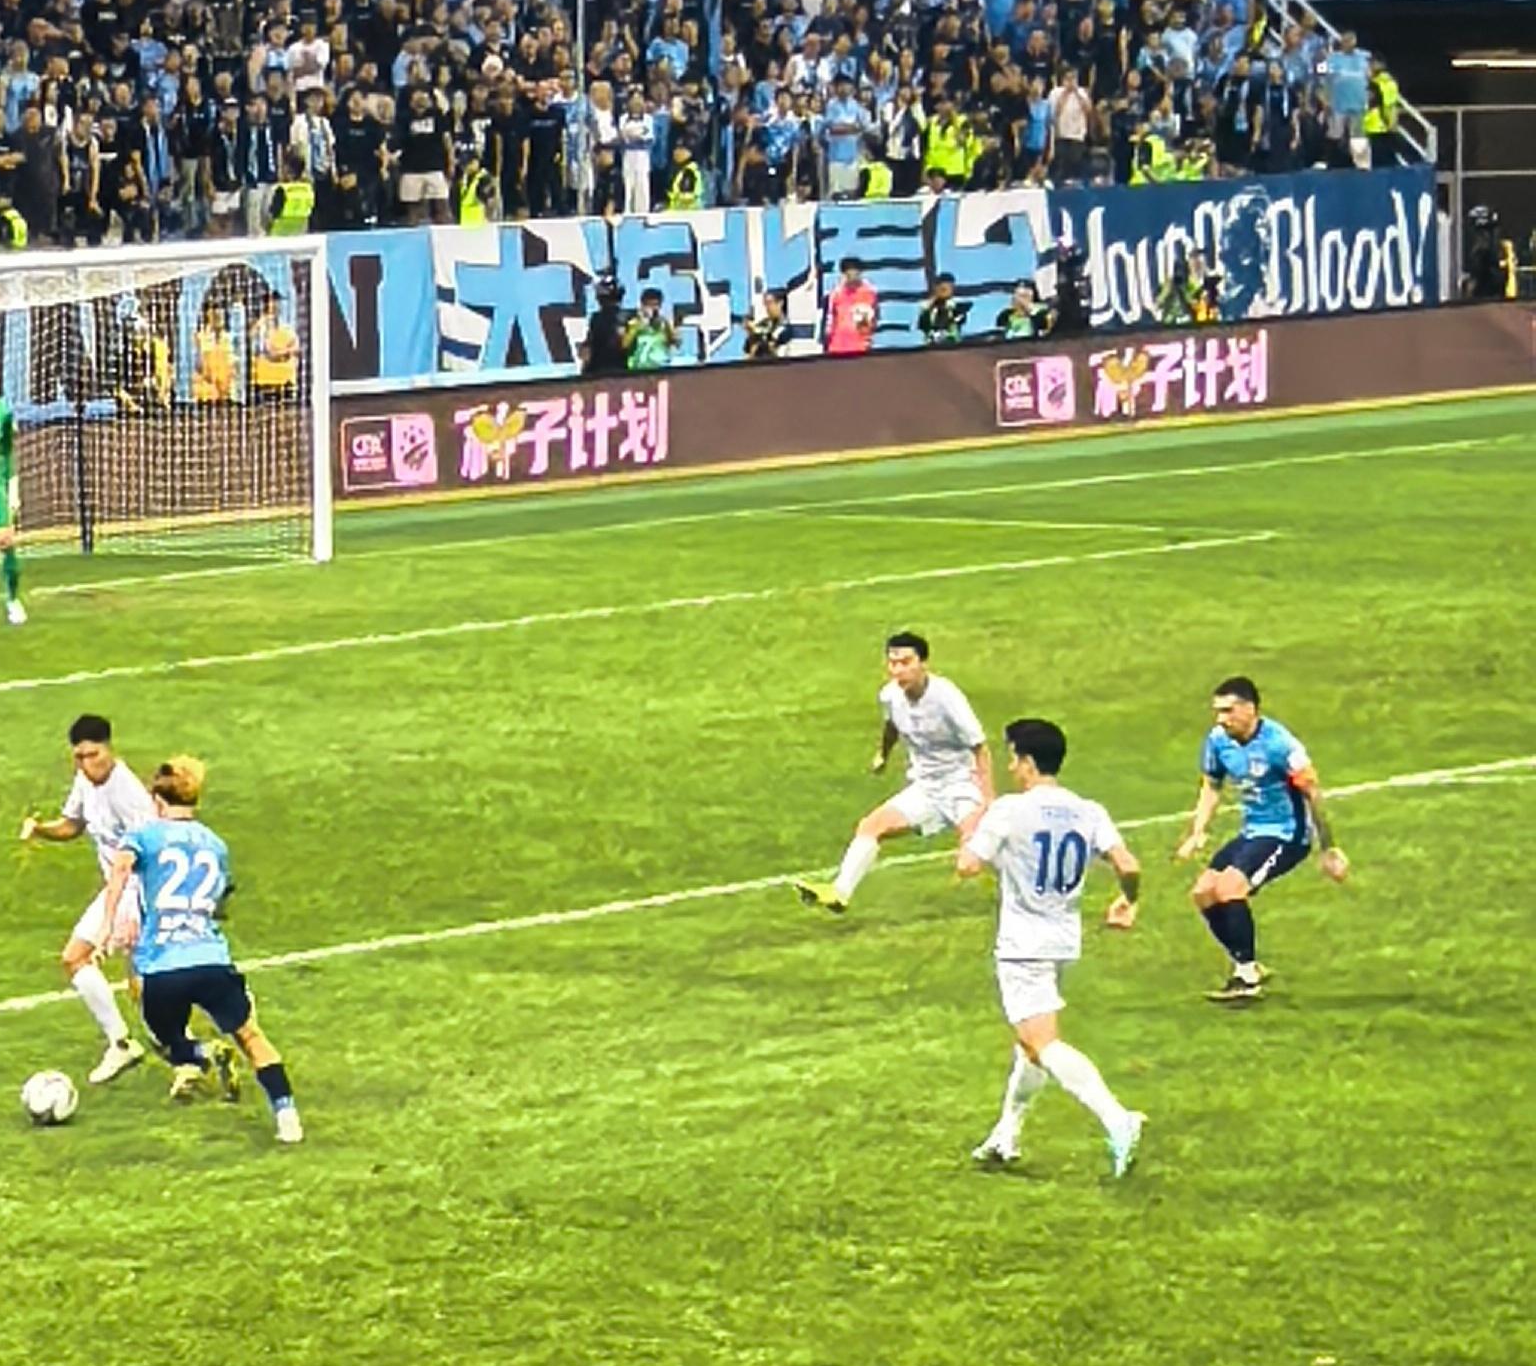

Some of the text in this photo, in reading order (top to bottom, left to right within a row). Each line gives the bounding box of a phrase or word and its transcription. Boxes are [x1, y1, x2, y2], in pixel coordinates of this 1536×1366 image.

[1262, 189, 1433, 316] Blood!
[154, 846, 222, 912] 22
[1032, 829, 1087, 896] 10
